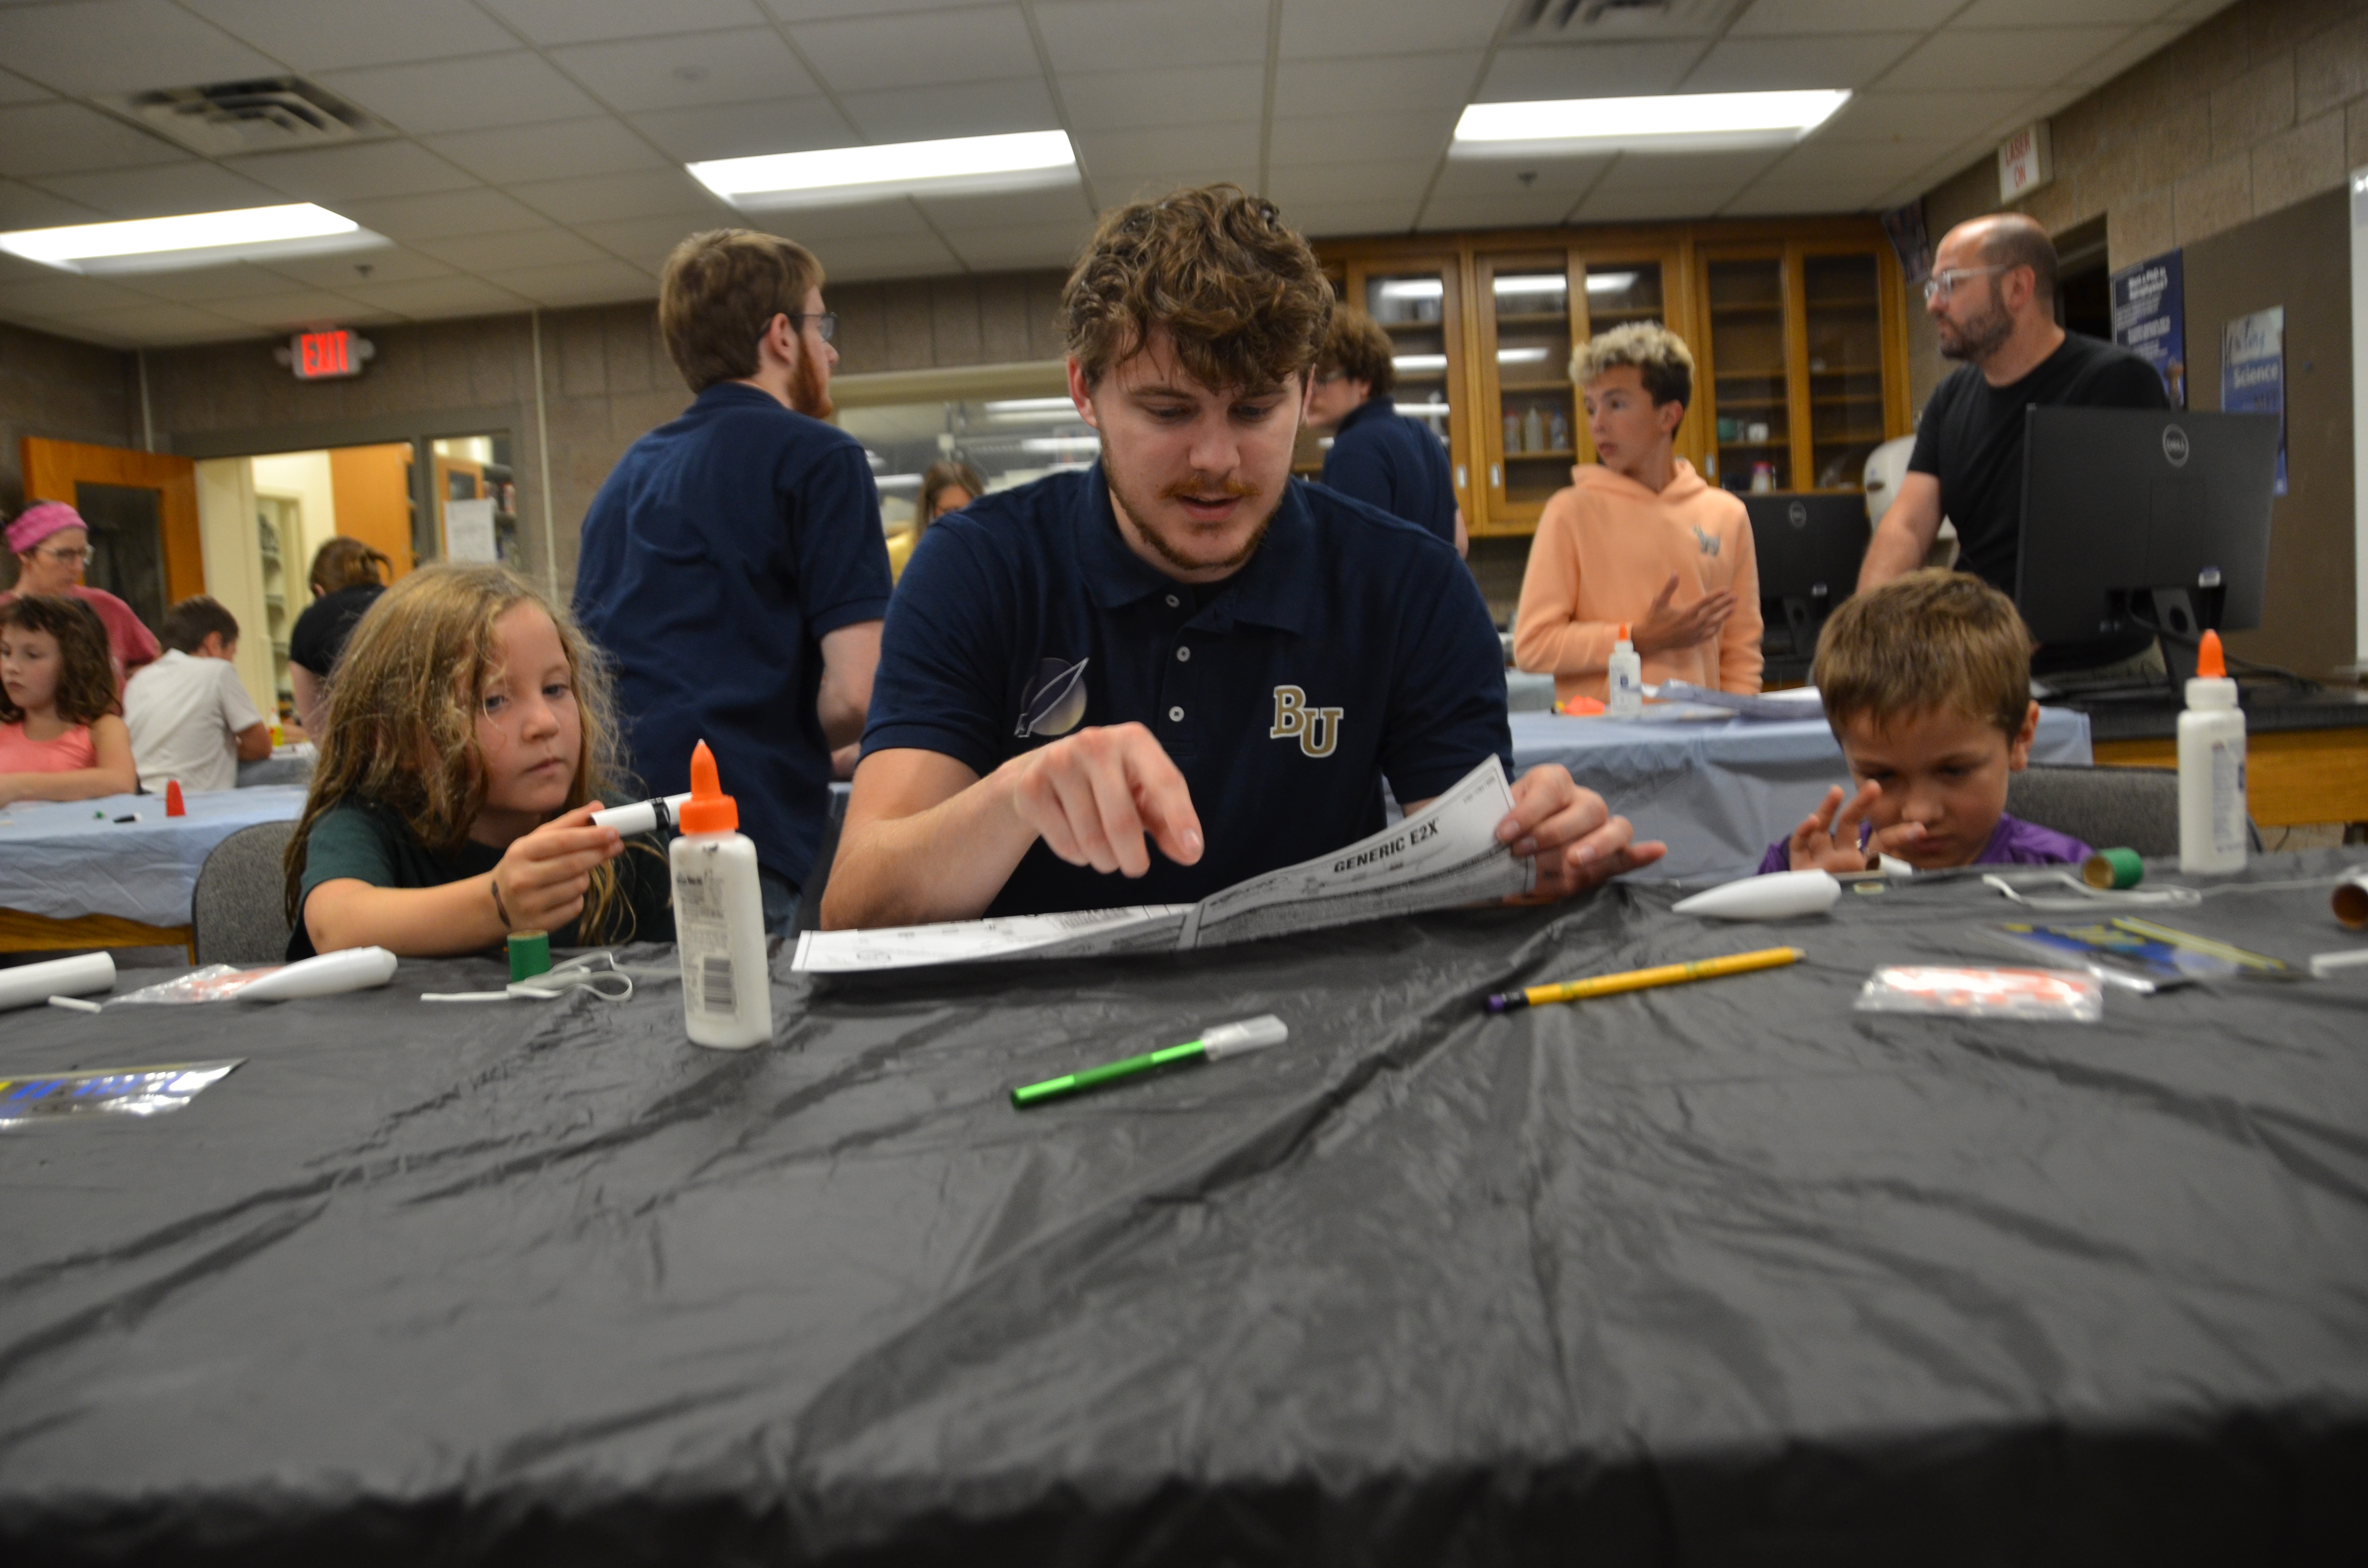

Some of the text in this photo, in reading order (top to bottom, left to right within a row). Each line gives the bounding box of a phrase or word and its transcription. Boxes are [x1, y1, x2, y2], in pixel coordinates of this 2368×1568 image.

[2005, 131, 2031, 167] LASER
[2014, 163, 2026, 189] ON
[300, 330, 349, 378] EXIT
[1270, 685, 1344, 758] BU
[1334, 819, 1438, 872] GENERIC E2X
